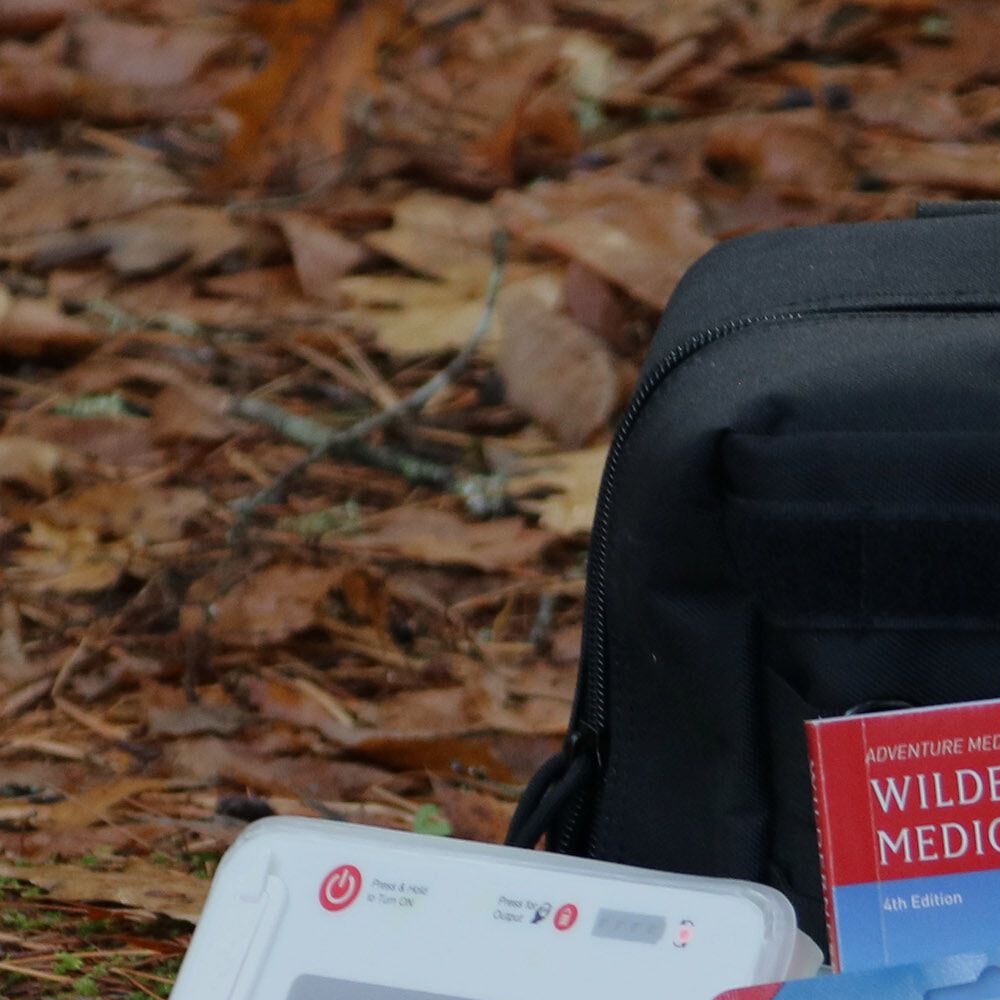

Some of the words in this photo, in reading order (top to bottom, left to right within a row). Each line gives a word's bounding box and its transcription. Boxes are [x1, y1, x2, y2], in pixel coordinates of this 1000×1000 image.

[865, 738, 963, 763] ADVENTURE
[883, 896, 908, 912] 4th
[911, 891, 963, 910] Edition
